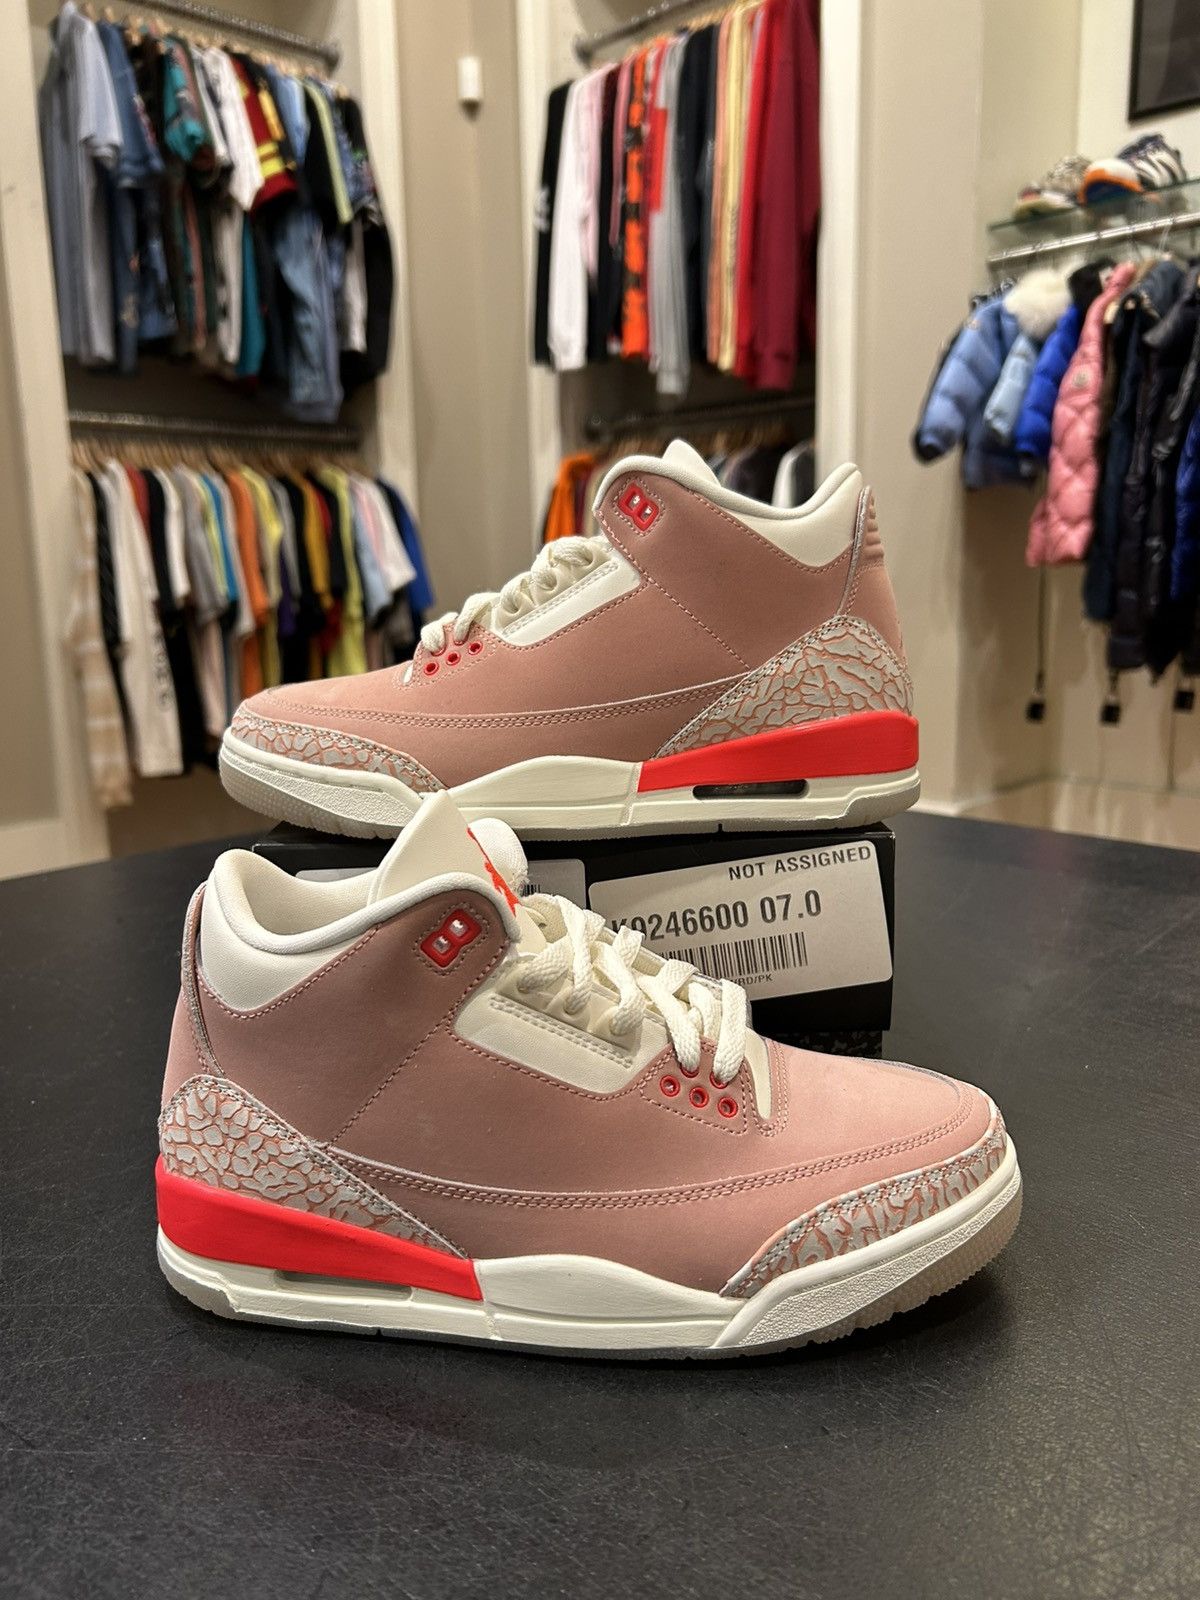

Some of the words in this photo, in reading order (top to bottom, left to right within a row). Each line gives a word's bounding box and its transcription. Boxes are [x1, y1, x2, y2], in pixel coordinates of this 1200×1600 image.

[728, 862, 766, 881] NOT
[774, 846, 871, 874] ASSIGNED
[759, 889, 822, 924] 07.0
